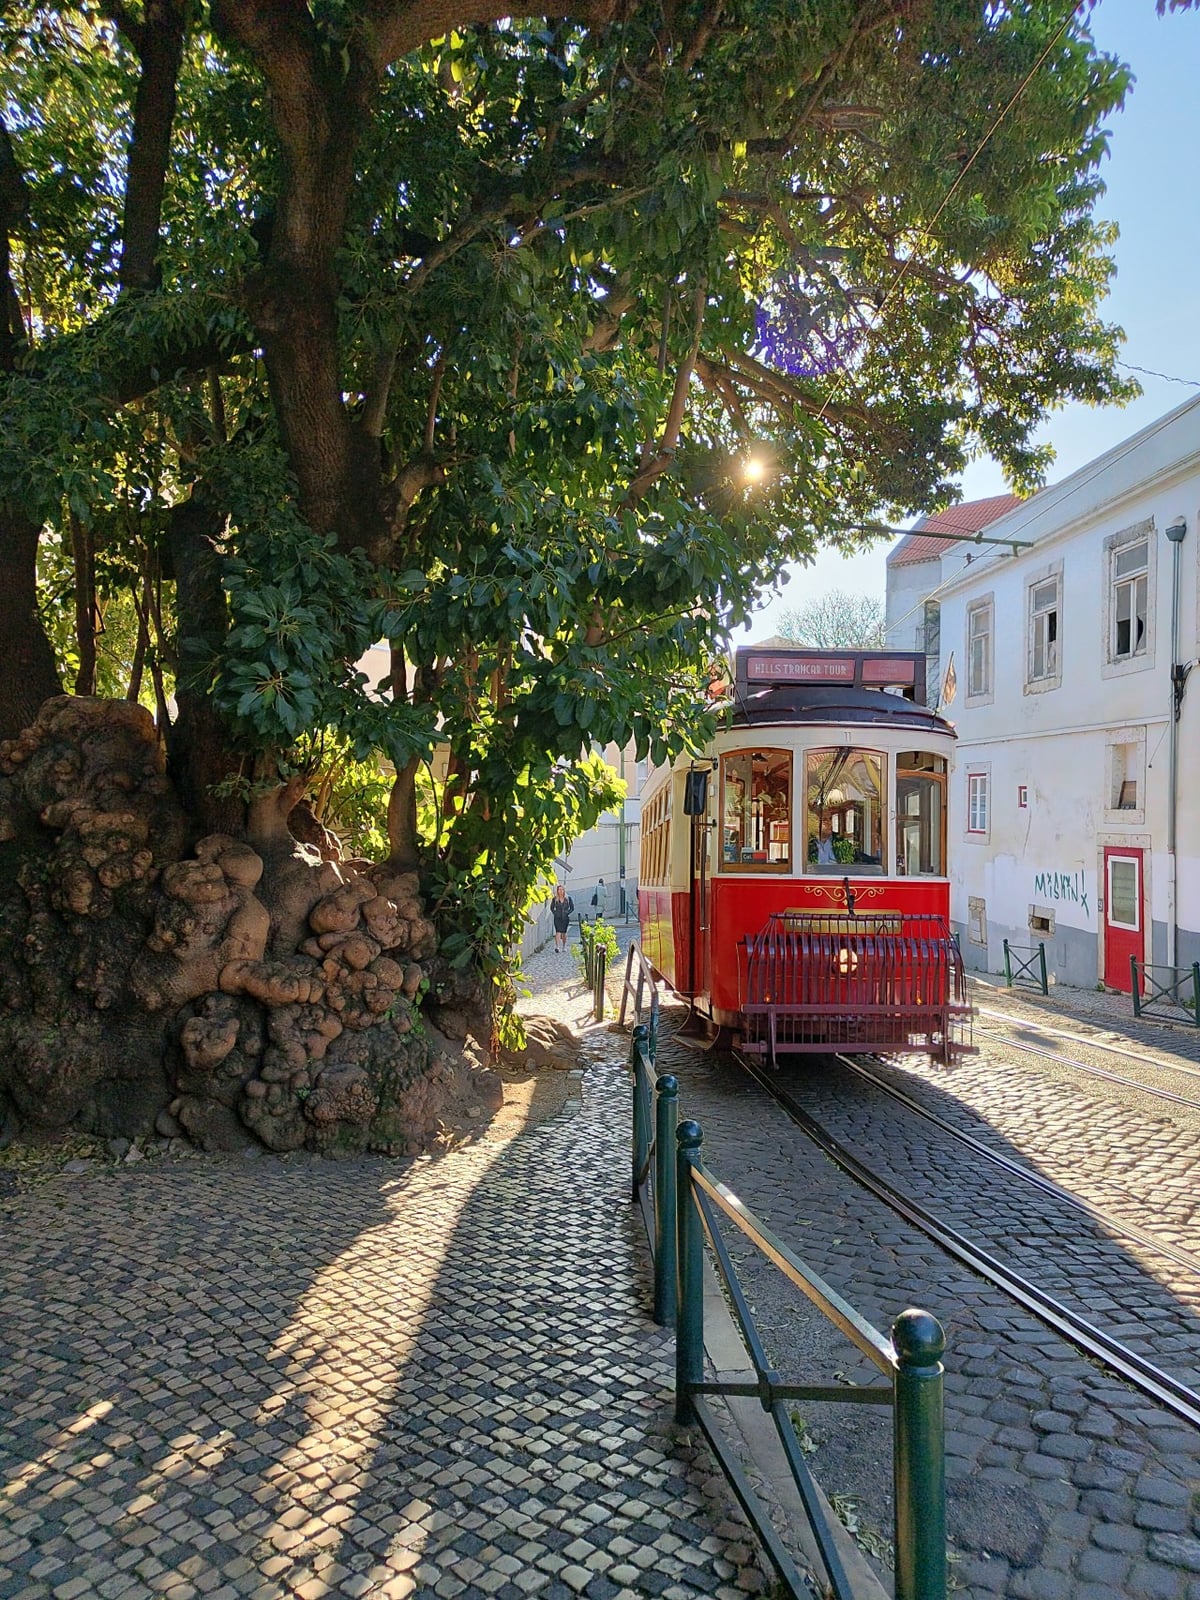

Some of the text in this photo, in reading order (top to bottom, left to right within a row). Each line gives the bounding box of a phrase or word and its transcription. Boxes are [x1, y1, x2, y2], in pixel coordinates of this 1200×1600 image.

[755, 663, 847, 676] HILLS TRAMCAR TOUR
